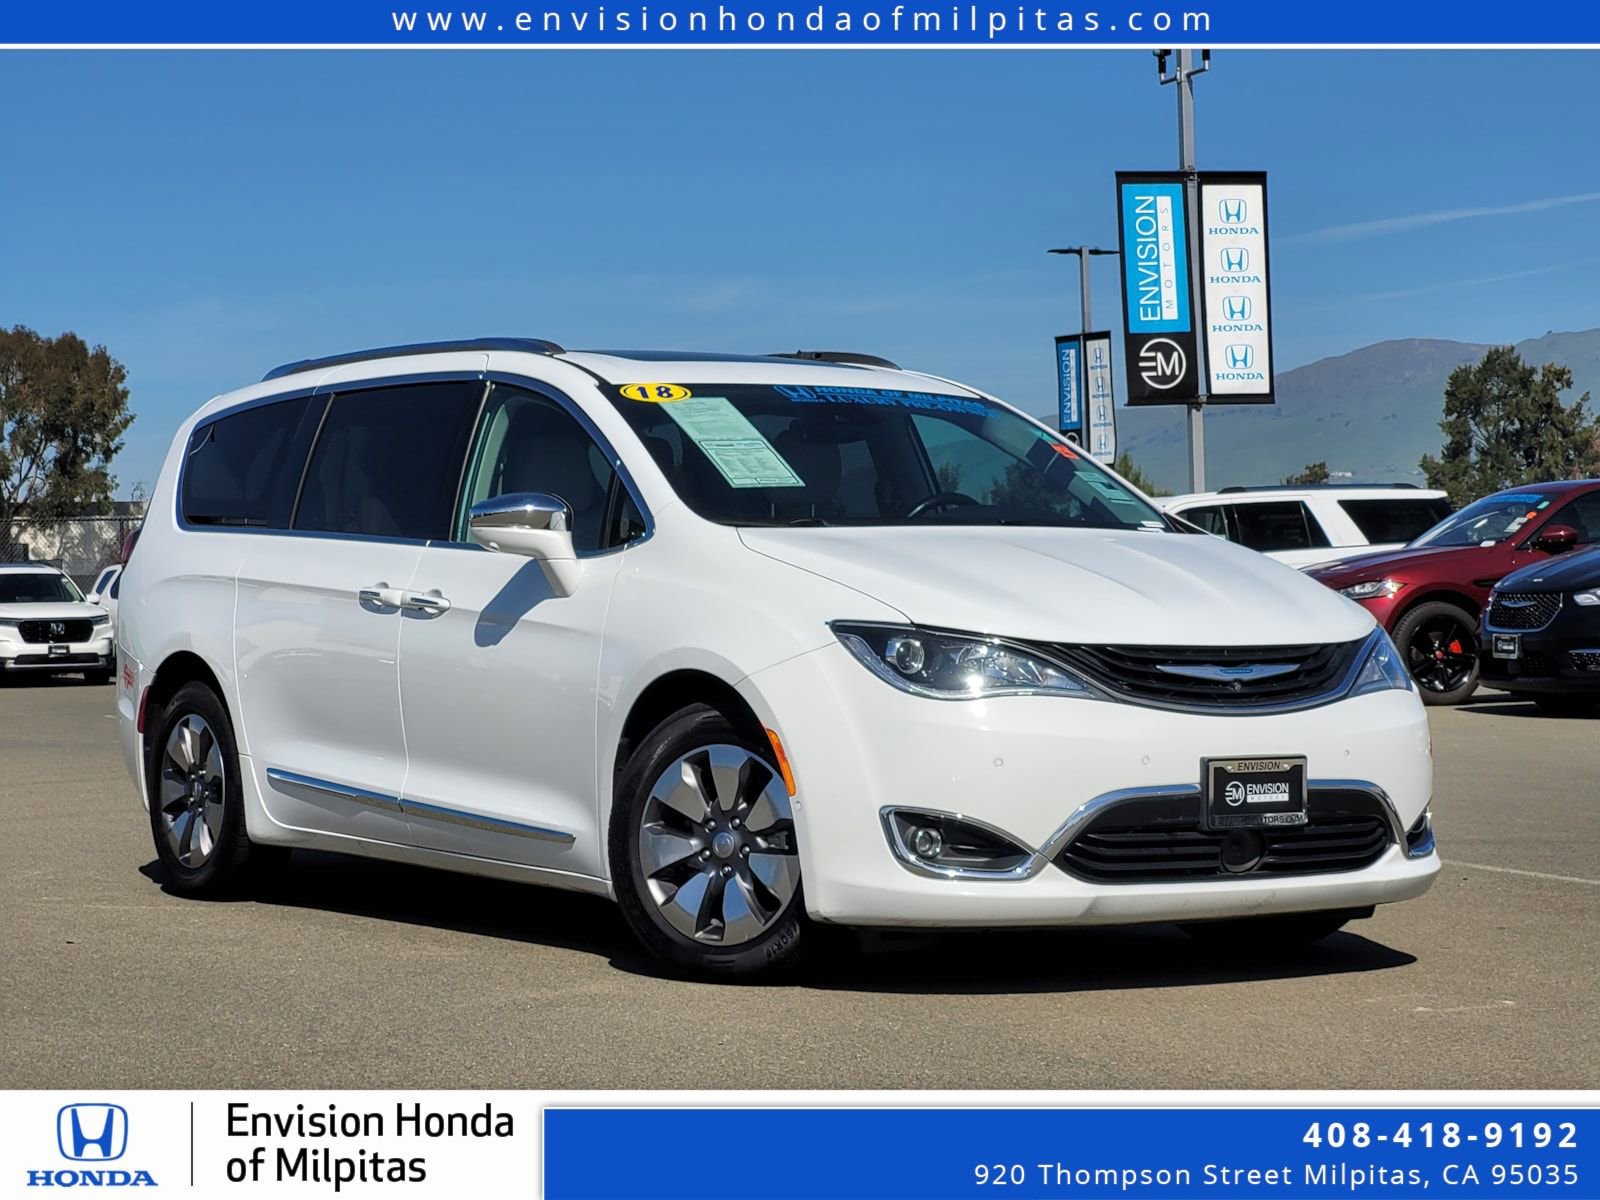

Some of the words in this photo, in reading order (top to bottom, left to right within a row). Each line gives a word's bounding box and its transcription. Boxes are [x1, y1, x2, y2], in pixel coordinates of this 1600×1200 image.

[1208, 227, 1259, 235] HONDA
[1135, 195, 1161, 321] ENVISION
[1161, 207, 1174, 309] MOTORS
[1210, 275, 1262, 283] HONDA
[1212, 324, 1263, 332] HONDA
[1215, 372, 1264, 380] HONDA
[1061, 349, 1072, 424] ENVISION
[636, 386, 674, 399] 18
[1238, 761, 1281, 771] ENVISION
[1246, 783, 1289, 795] ENVISION
